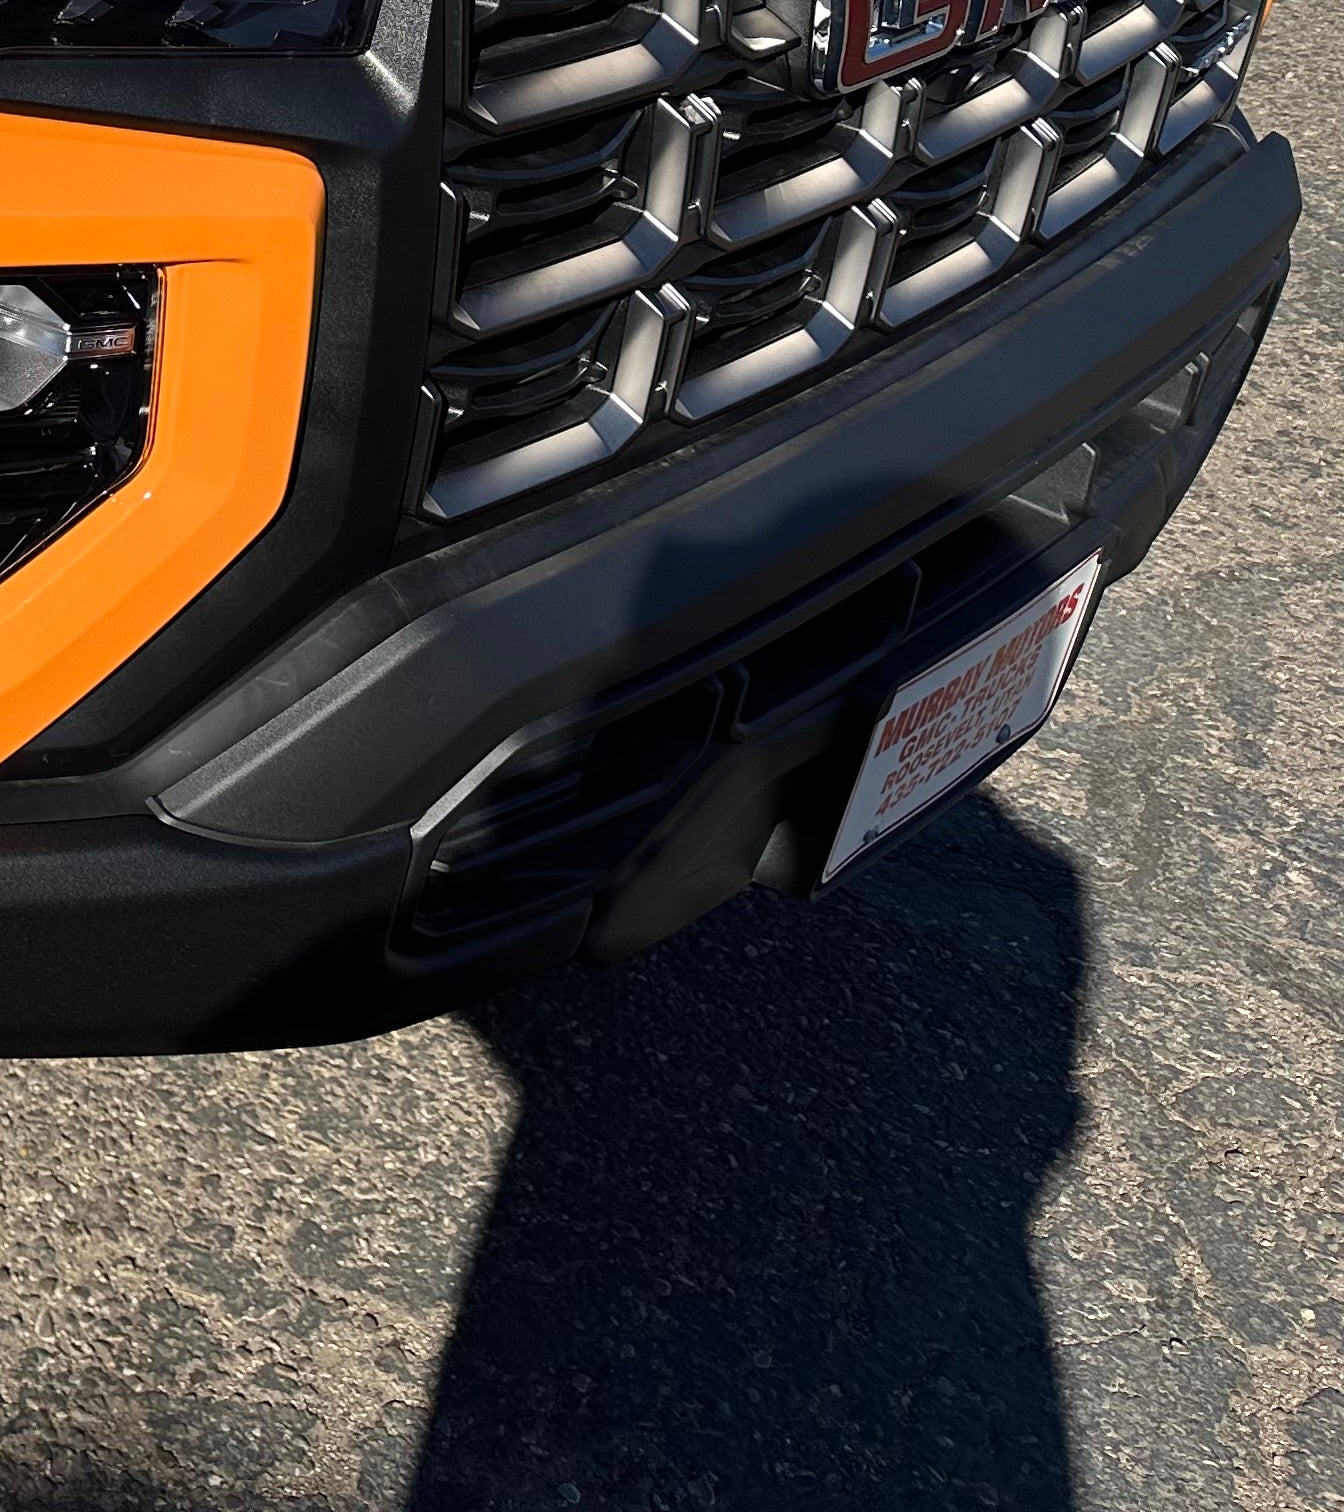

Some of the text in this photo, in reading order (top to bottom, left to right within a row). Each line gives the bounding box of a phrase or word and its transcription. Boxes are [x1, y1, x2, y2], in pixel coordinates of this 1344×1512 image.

[873, 582, 1085, 758] MURRAY MOTORS
[962, 644, 1043, 719] TRUCKS
[990, 666, 1038, 715] UTAH
